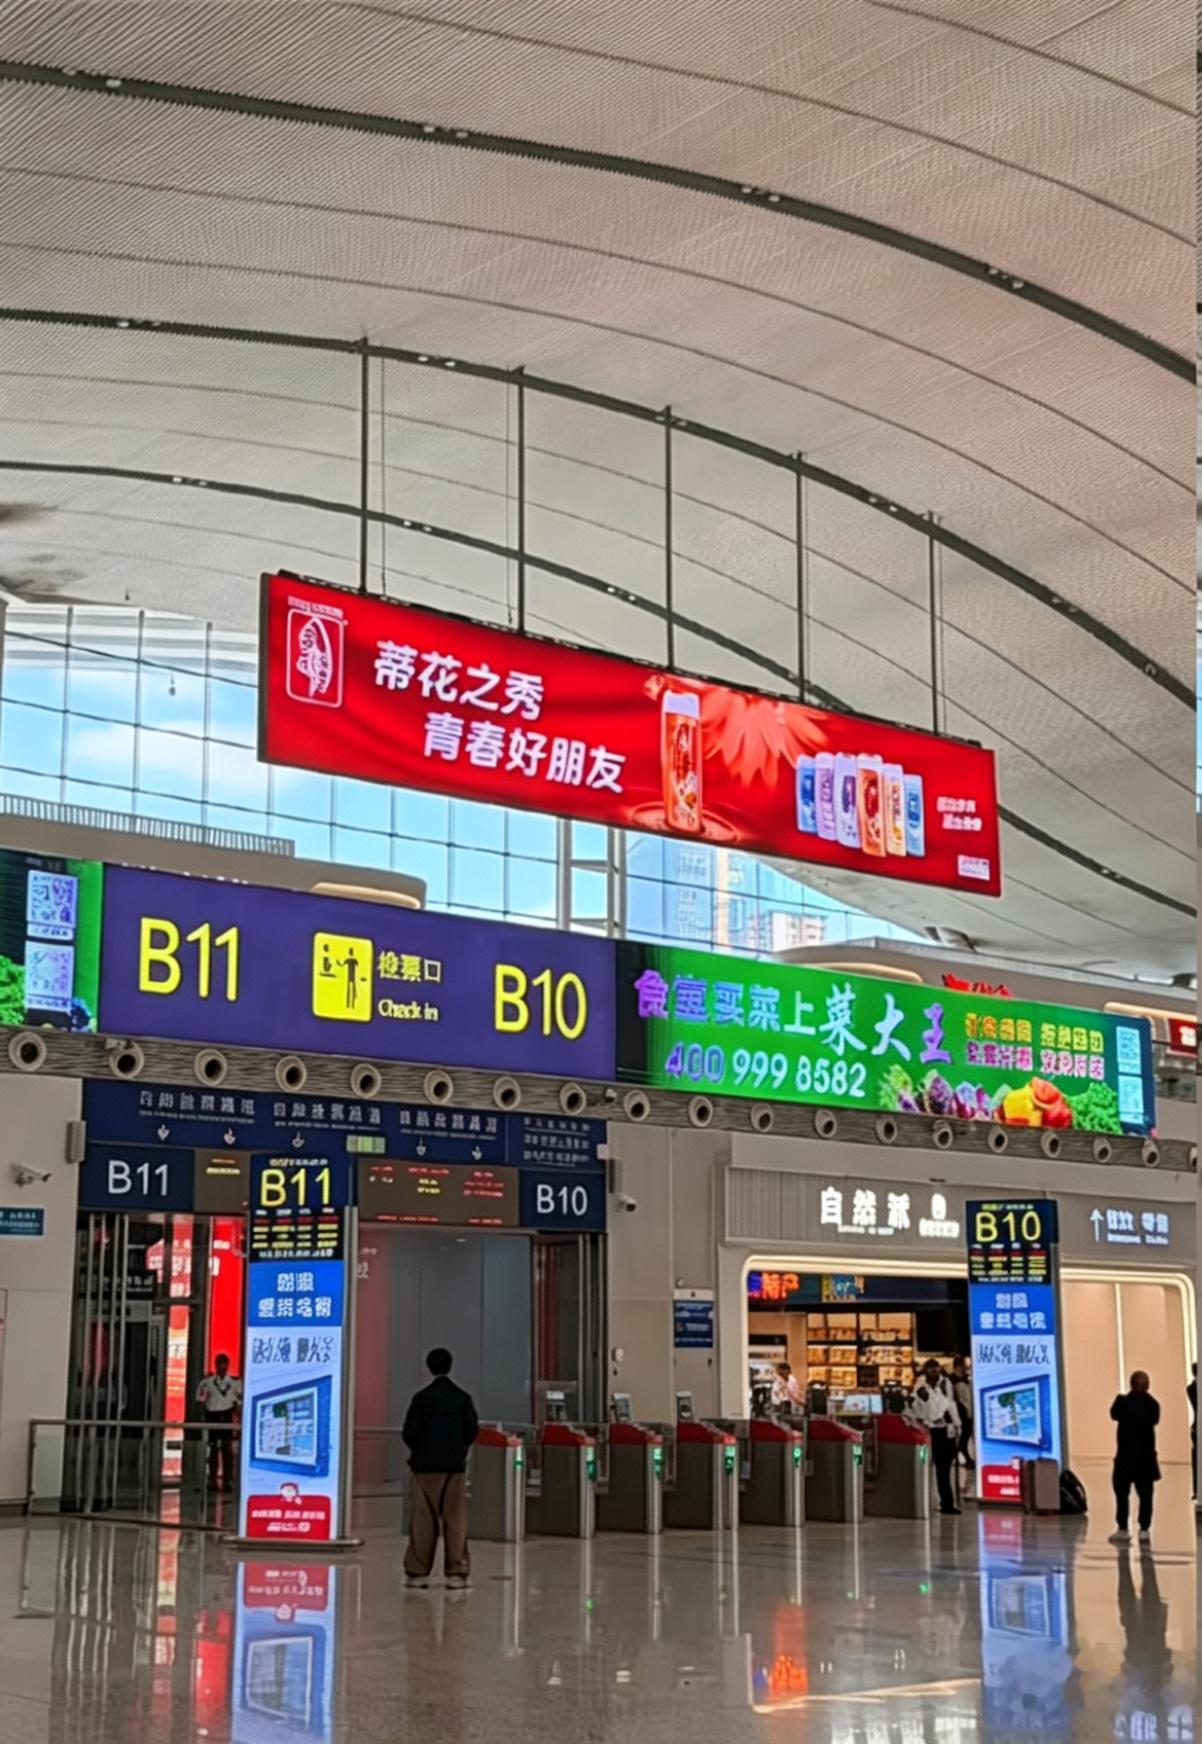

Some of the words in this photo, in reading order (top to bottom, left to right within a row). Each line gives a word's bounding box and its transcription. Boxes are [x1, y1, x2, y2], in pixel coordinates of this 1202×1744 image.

[375, 642, 544, 719] 蒂花之秀
[424, 713, 625, 793] 青春好朋友
[138, 916, 240, 1001] B11
[493, 964, 587, 1040] B10
[665, 1041, 724, 1084] 400
[732, 1049, 788, 1088] 999
[796, 1055, 866, 1098] 8582
[108, 1160, 168, 1196] B11
[260, 1168, 331, 1206] B11
[536, 1184, 588, 1216] B10
[820, 1185, 910, 1229] 自然派
[975, 1211, 1042, 1243] B10
